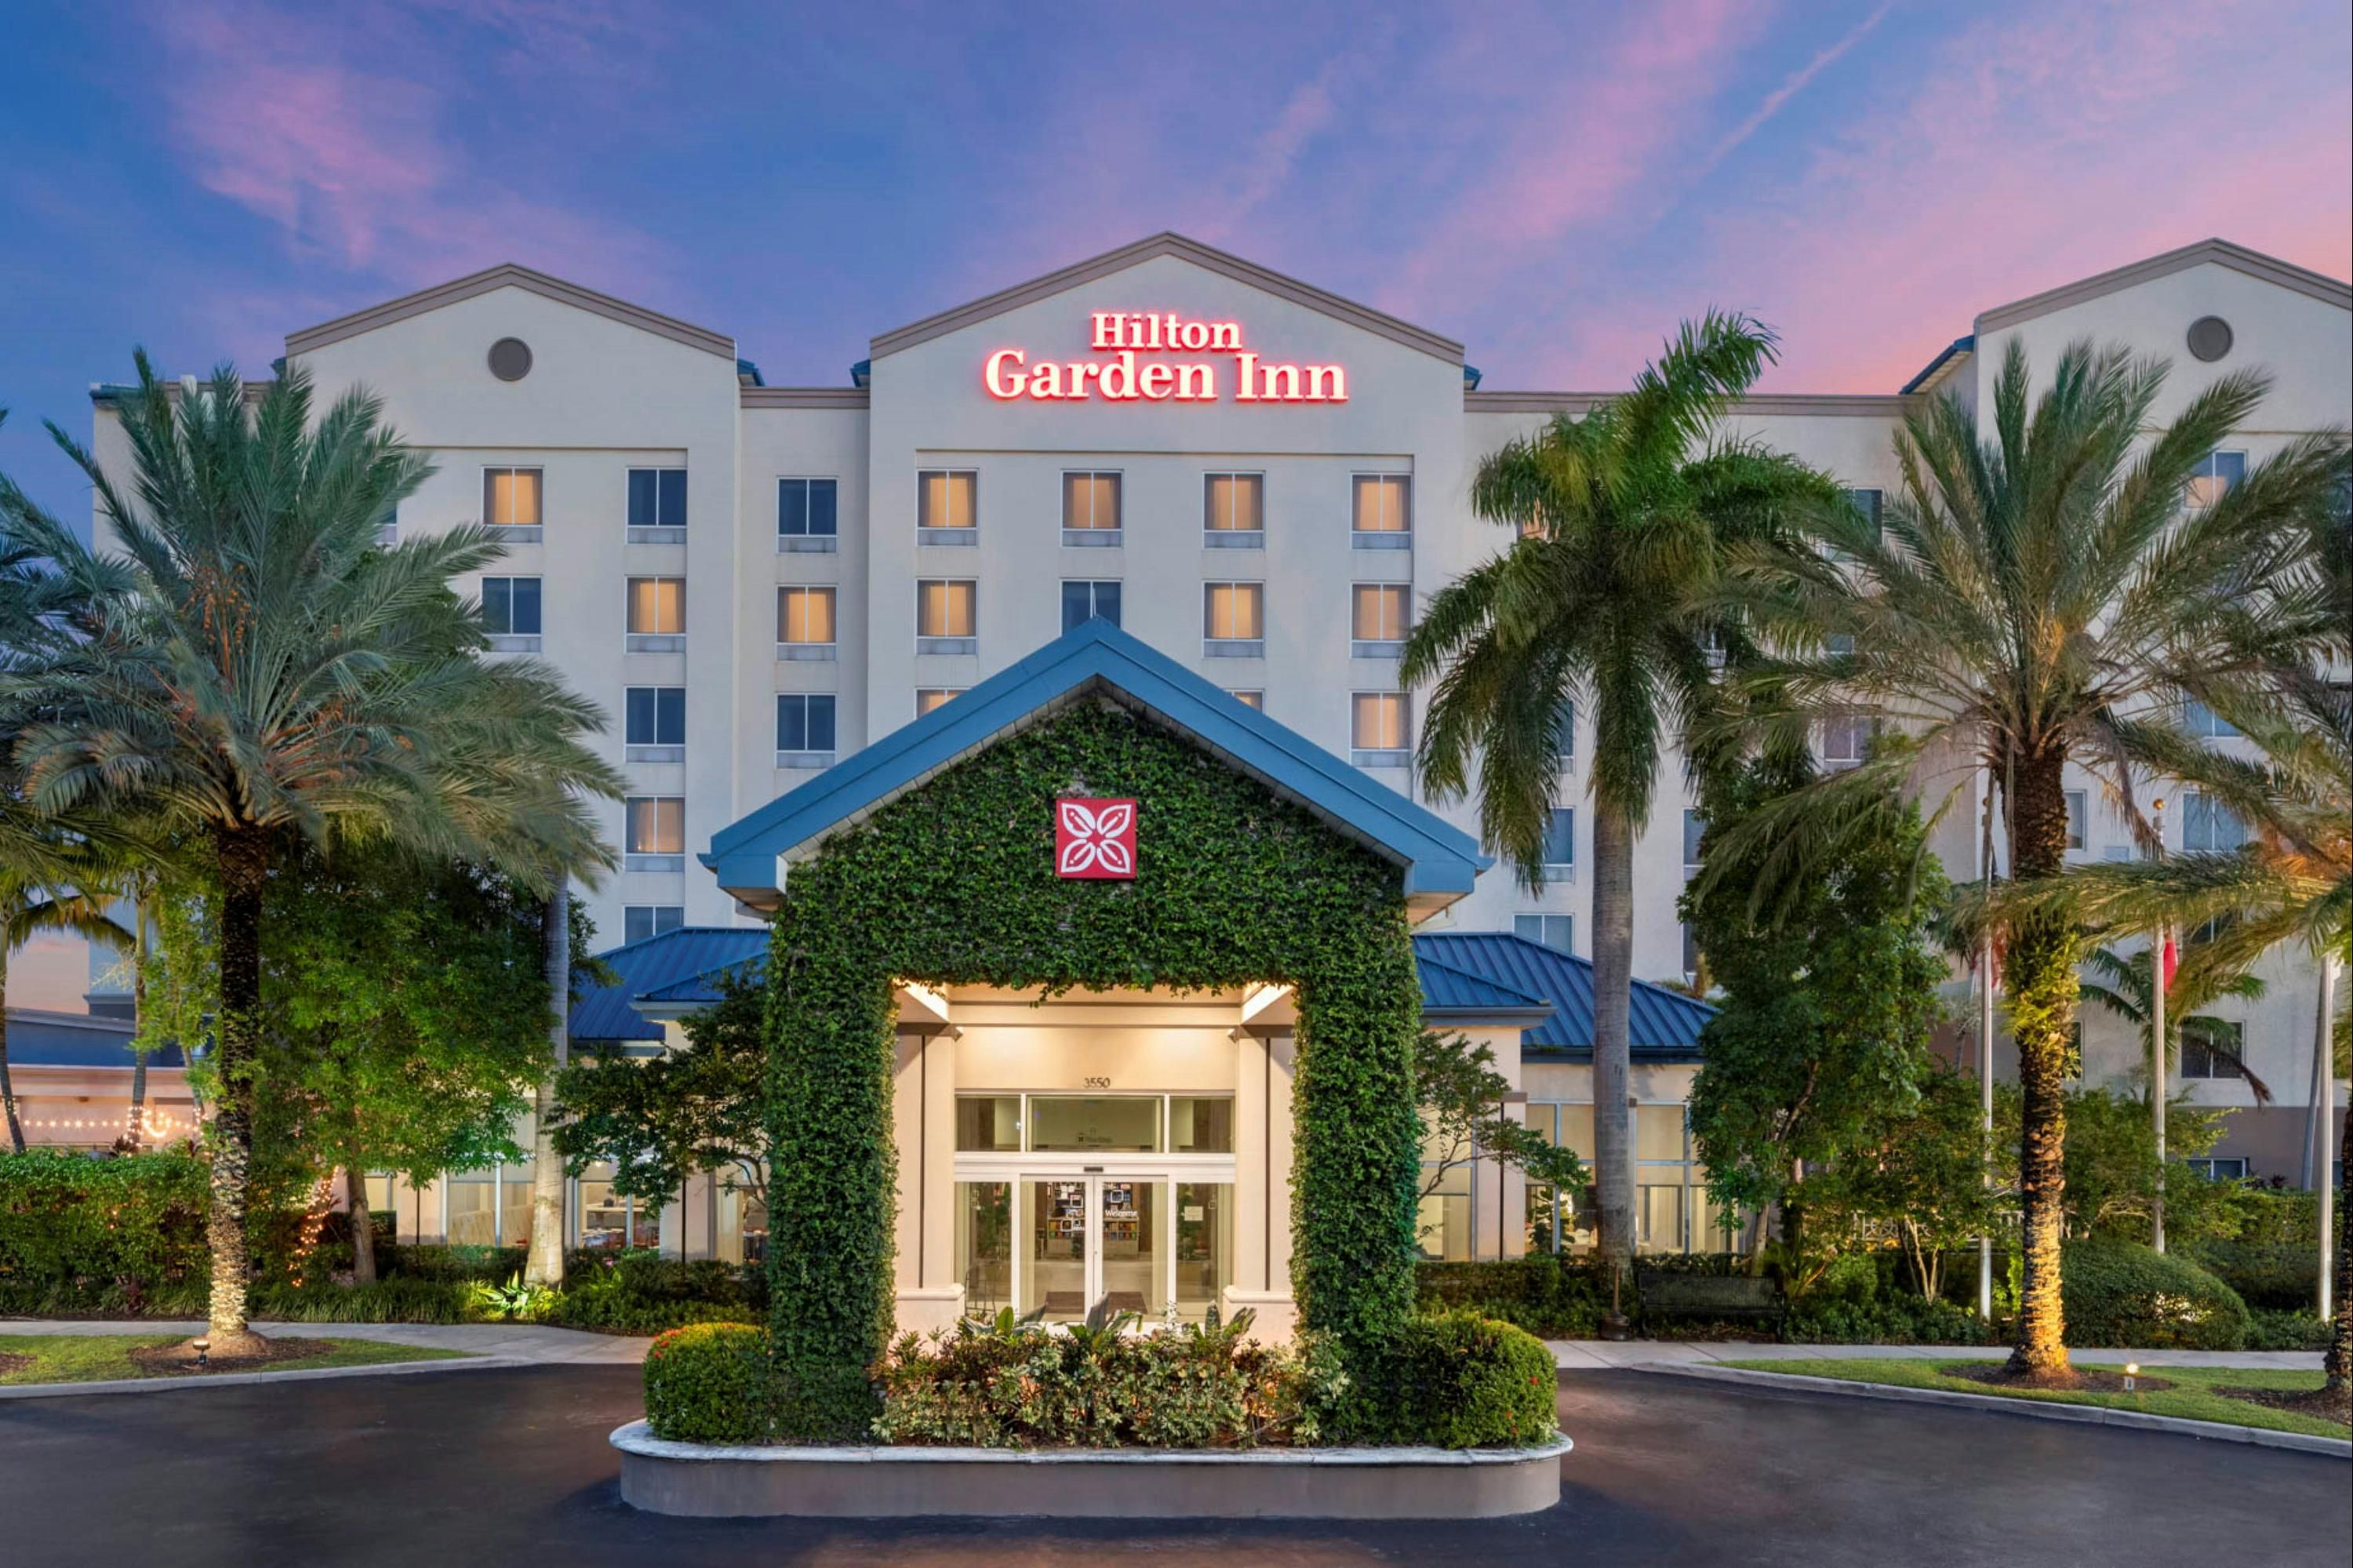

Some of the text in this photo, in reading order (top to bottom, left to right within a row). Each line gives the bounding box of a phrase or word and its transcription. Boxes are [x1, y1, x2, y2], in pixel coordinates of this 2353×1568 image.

[1091, 313, 1243, 350] Hilton
[985, 349, 1349, 401] Garden Inn
[1082, 1077, 1111, 1089] 3550
[1104, 1209, 1138, 1217] Welcome
